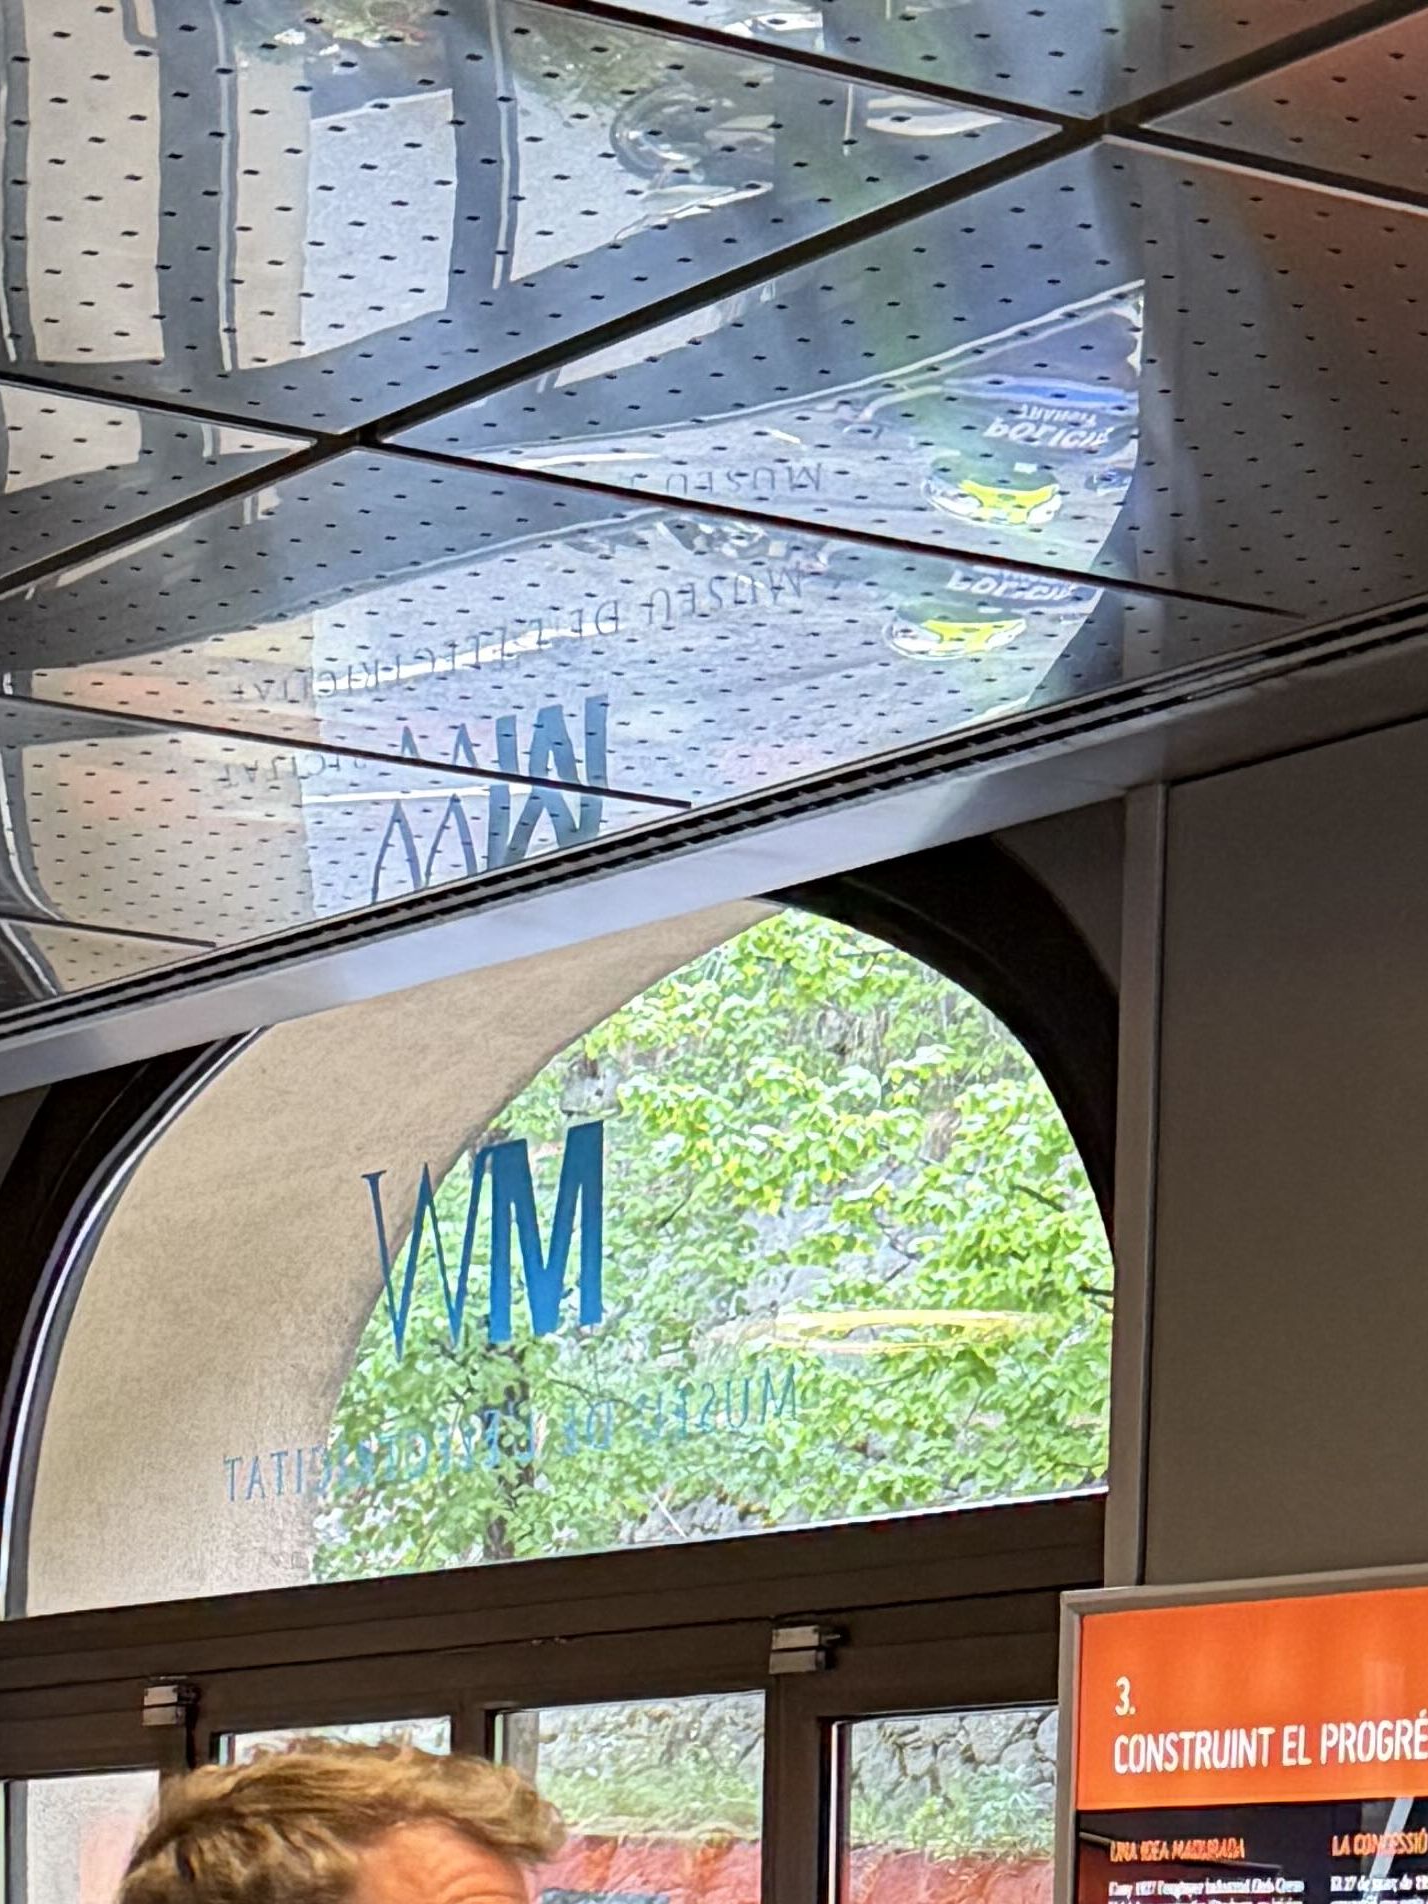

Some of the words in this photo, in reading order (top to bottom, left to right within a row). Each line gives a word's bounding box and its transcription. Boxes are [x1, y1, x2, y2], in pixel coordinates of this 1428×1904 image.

[1114, 1676, 1136, 1716] 3.
[1113, 1726, 1276, 1775] CONSTRUINT
[1281, 1724, 1312, 1767] EL
